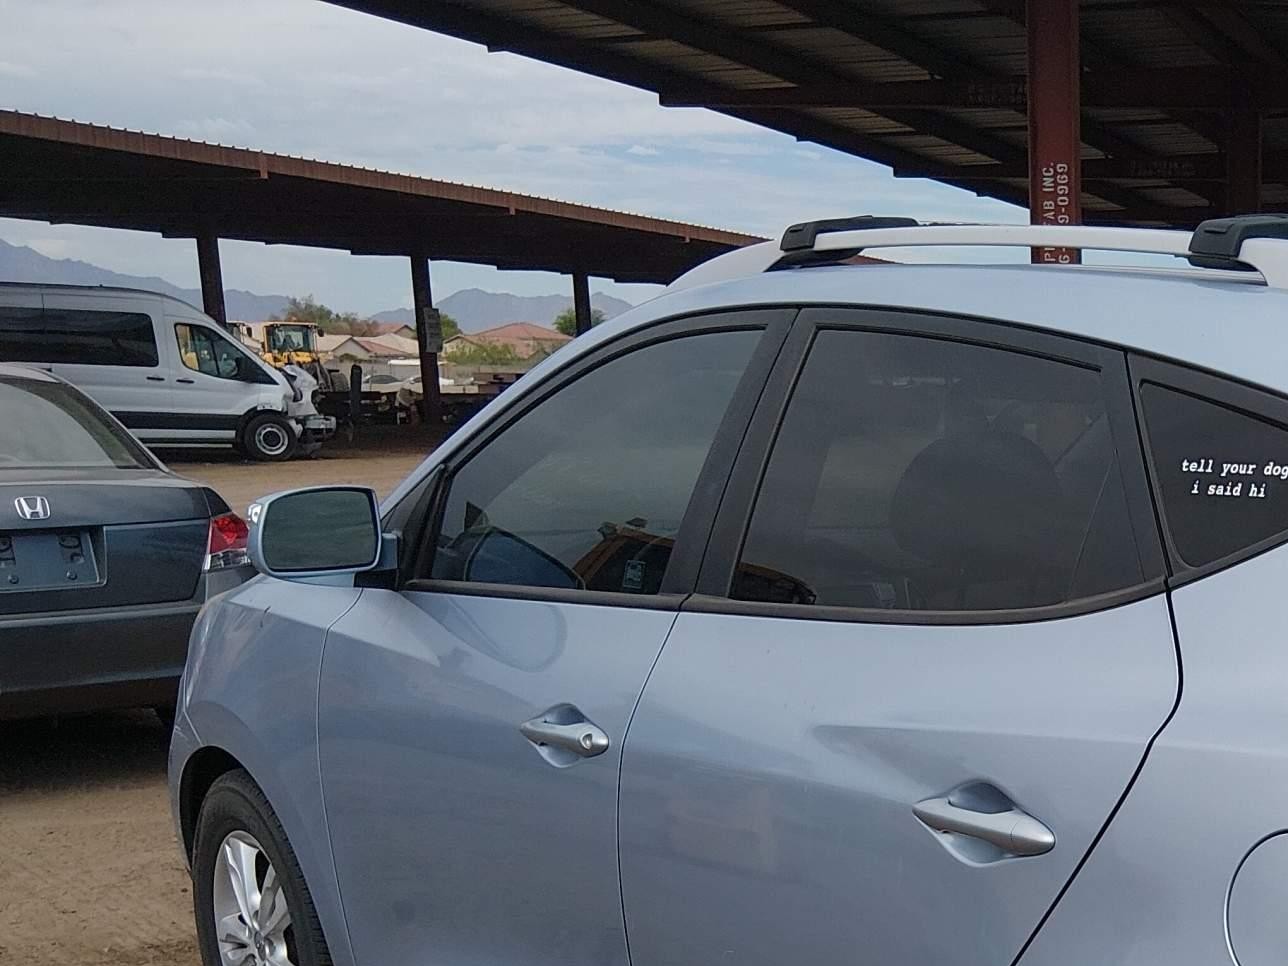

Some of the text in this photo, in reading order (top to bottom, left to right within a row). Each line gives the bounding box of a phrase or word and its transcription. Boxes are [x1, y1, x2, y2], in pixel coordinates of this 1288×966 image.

[1042, 162, 1055, 192] INC.
[1181, 459, 1214, 473] tell
[1220, 463, 1257, 477] your
[1191, 480, 1266, 498] i said hi
